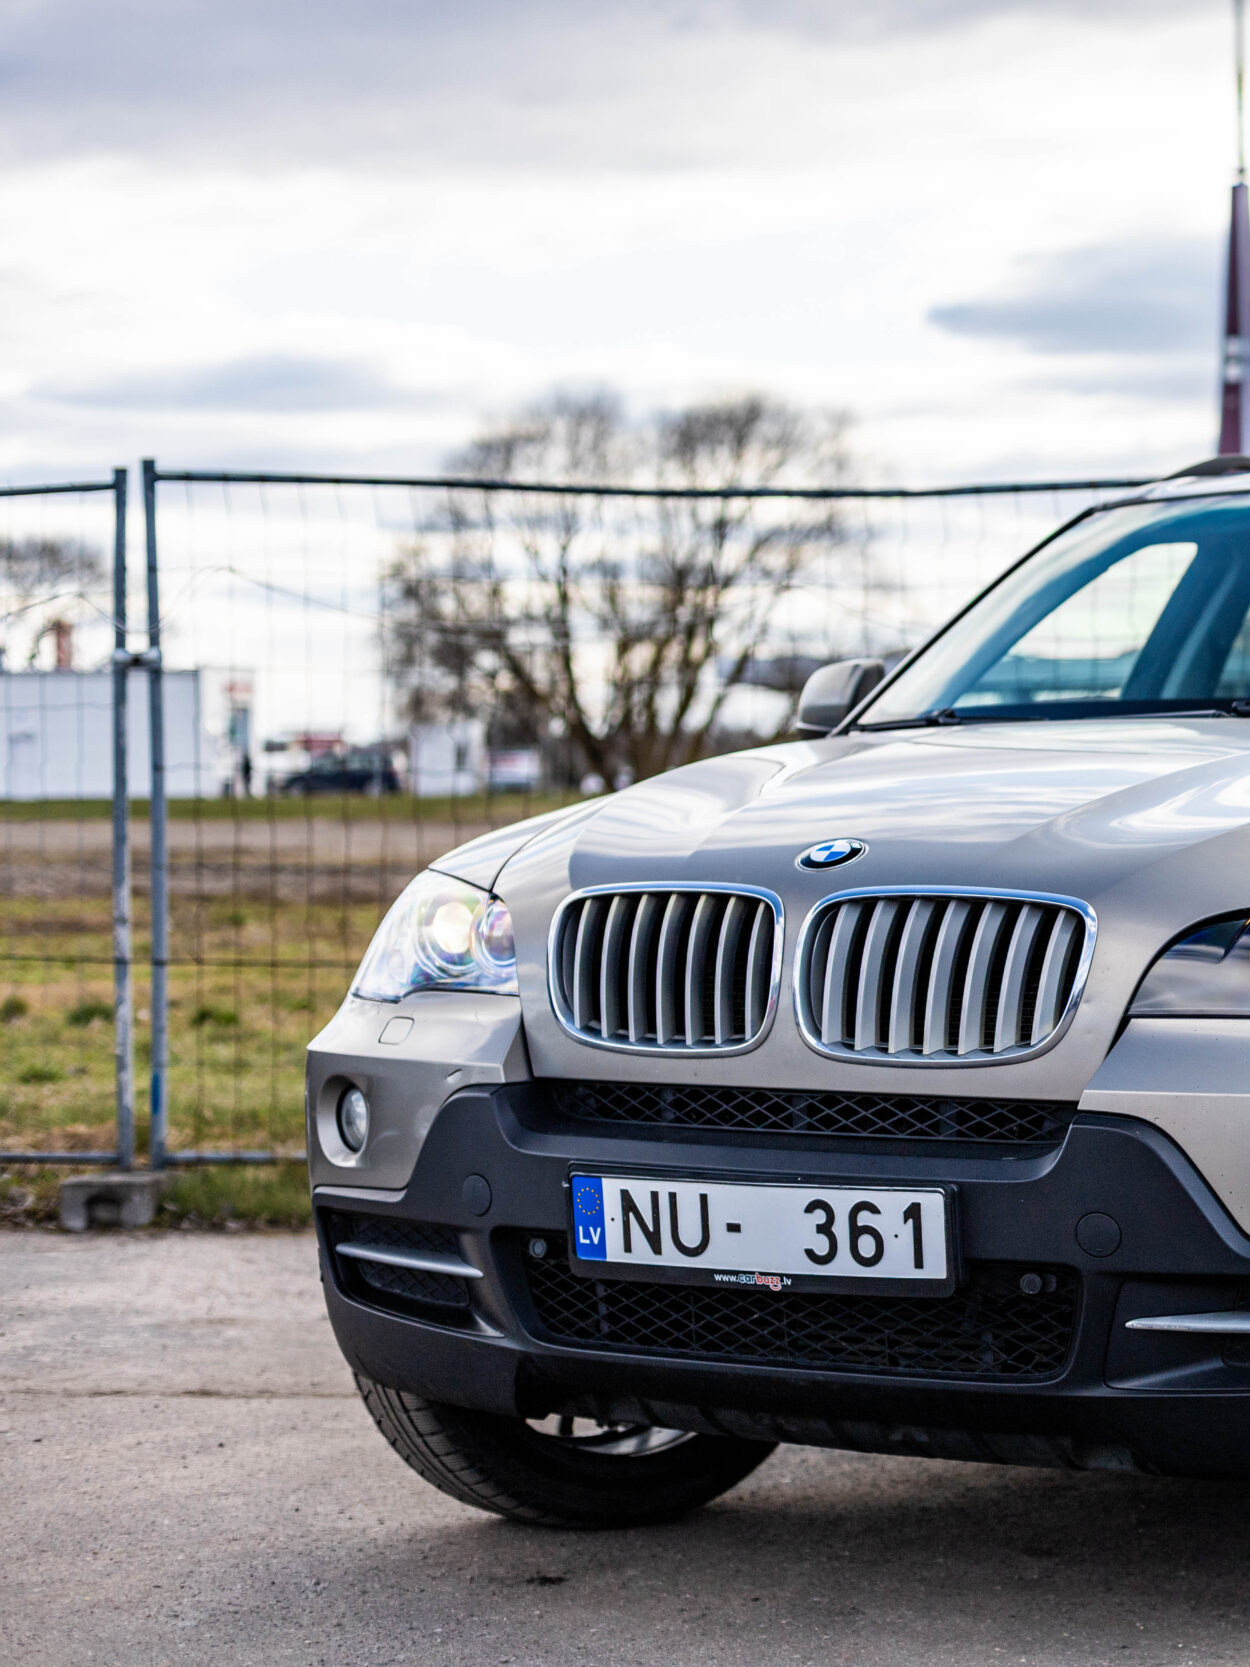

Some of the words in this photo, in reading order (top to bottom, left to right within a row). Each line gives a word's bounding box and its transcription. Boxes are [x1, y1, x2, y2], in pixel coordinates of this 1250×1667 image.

[578, 1225, 601, 1245] LV
[803, 1198, 925, 1270] 361
[713, 1271, 792, 1288] www.carbuzz.lv
